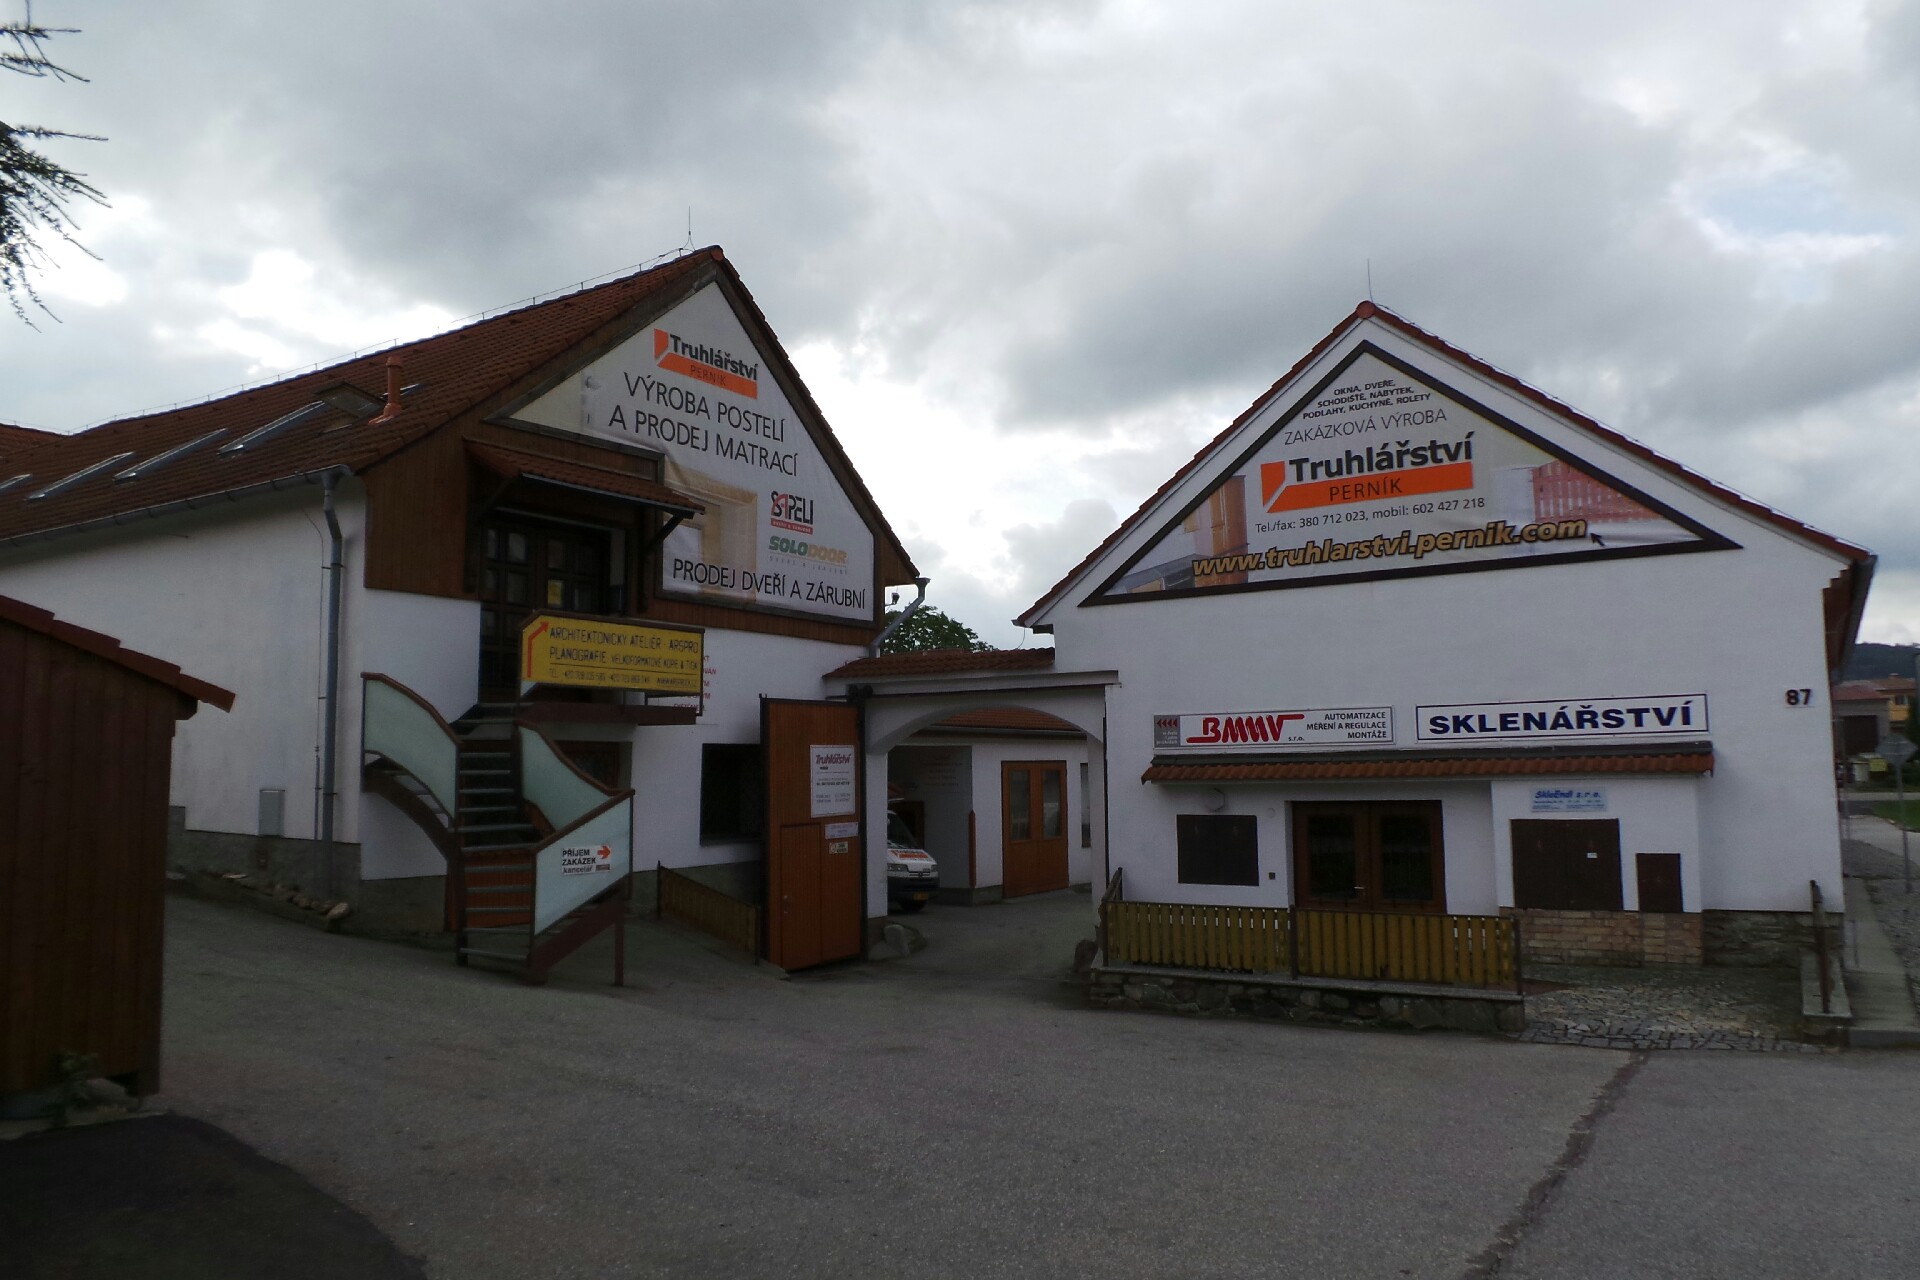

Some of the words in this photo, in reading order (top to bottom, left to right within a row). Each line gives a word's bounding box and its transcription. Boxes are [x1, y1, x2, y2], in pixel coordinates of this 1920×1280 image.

[669, 333, 759, 381] Truhlářství
[623, 371, 711, 420] VÝROBA
[717, 401, 786, 443] POSTELÍ
[1303, 407, 1346, 420] PODLAHY,
[1396, 393, 1431, 405] ROLETY
[608, 404, 628, 431] A
[635, 409, 709, 452] PRODEJ
[716, 434, 799, 477] MATRACÍ
[1284, 415, 1376, 446] ZAKÁZKOVÁ
[1381, 408, 1447, 430] VÝROBA
[1288, 431, 1476, 482] Truhlářství
[1329, 476, 1403, 502] PERNÍK
[770, 490, 814, 525] SAPELI
[1255, 519, 1297, 534] Tel./fax:
[1299, 517, 1319, 528] 380
[1323, 513, 1342, 525] 712
[1345, 510, 1368, 522] 023,
[1372, 505, 1409, 519] mobil:
[1412, 502, 1434, 514] 602
[1438, 499, 1459, 511] 427
[1463, 497, 1485, 509] 218
[1191, 517, 1588, 577] www.truhlarstvi.pernik.com
[672, 558, 737, 589] PRODEJ
[742, 571, 786, 598] DVEŘÍ
[789, 580, 802, 600] A
[806, 581, 867, 610] ZÁRUBNÍ
[1786, 688, 1811, 705] 87
[1324, 711, 1386, 721] AUTOMATIZACE
[1345, 721, 1387, 730] REGULACE
[1428, 700, 1694, 735] SKLENÁŘSTVÍ
[1347, 729, 1387, 739] MONTÁŽE
[562, 848, 590, 857] PŘÍJEM
